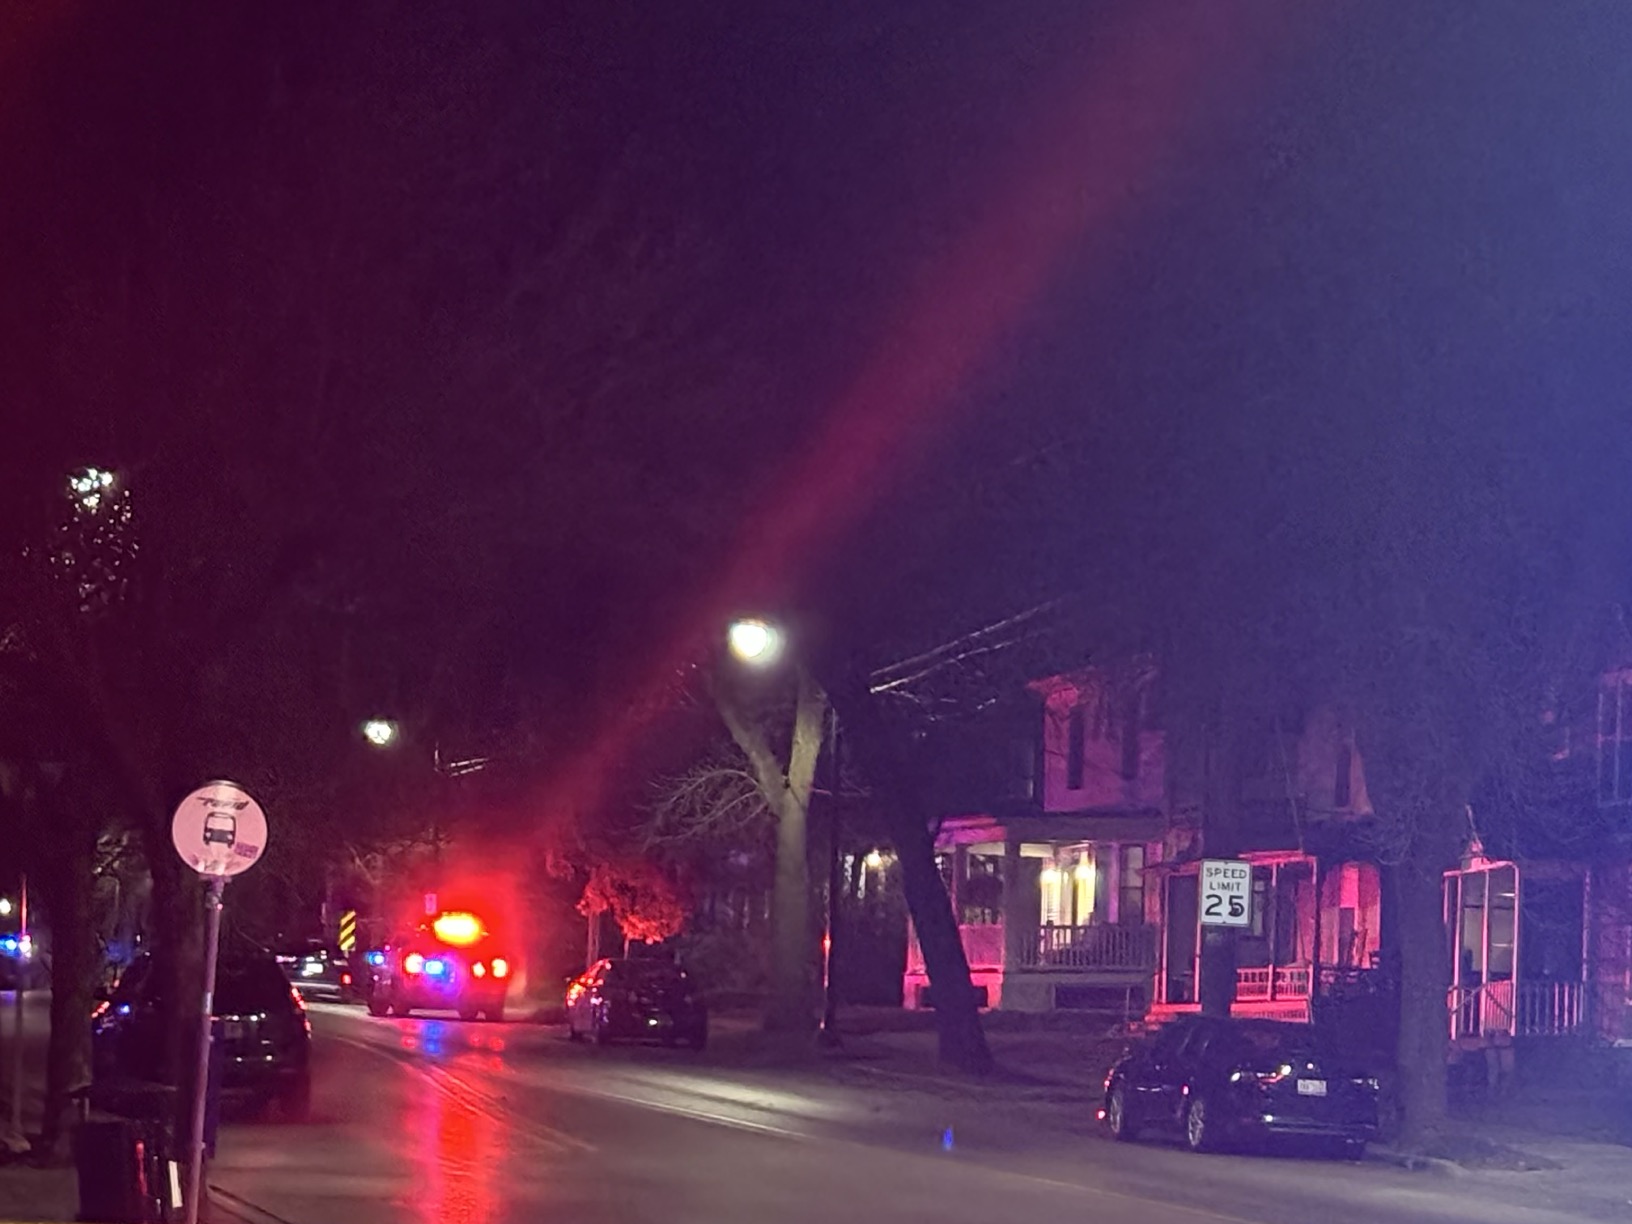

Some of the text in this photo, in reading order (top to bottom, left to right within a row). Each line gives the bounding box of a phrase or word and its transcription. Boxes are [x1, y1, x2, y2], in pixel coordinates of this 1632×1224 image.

[1205, 867, 1247, 879] SPEED
[1209, 881, 1241, 892] LIMIT
[1204, 894, 1245, 918] 25
